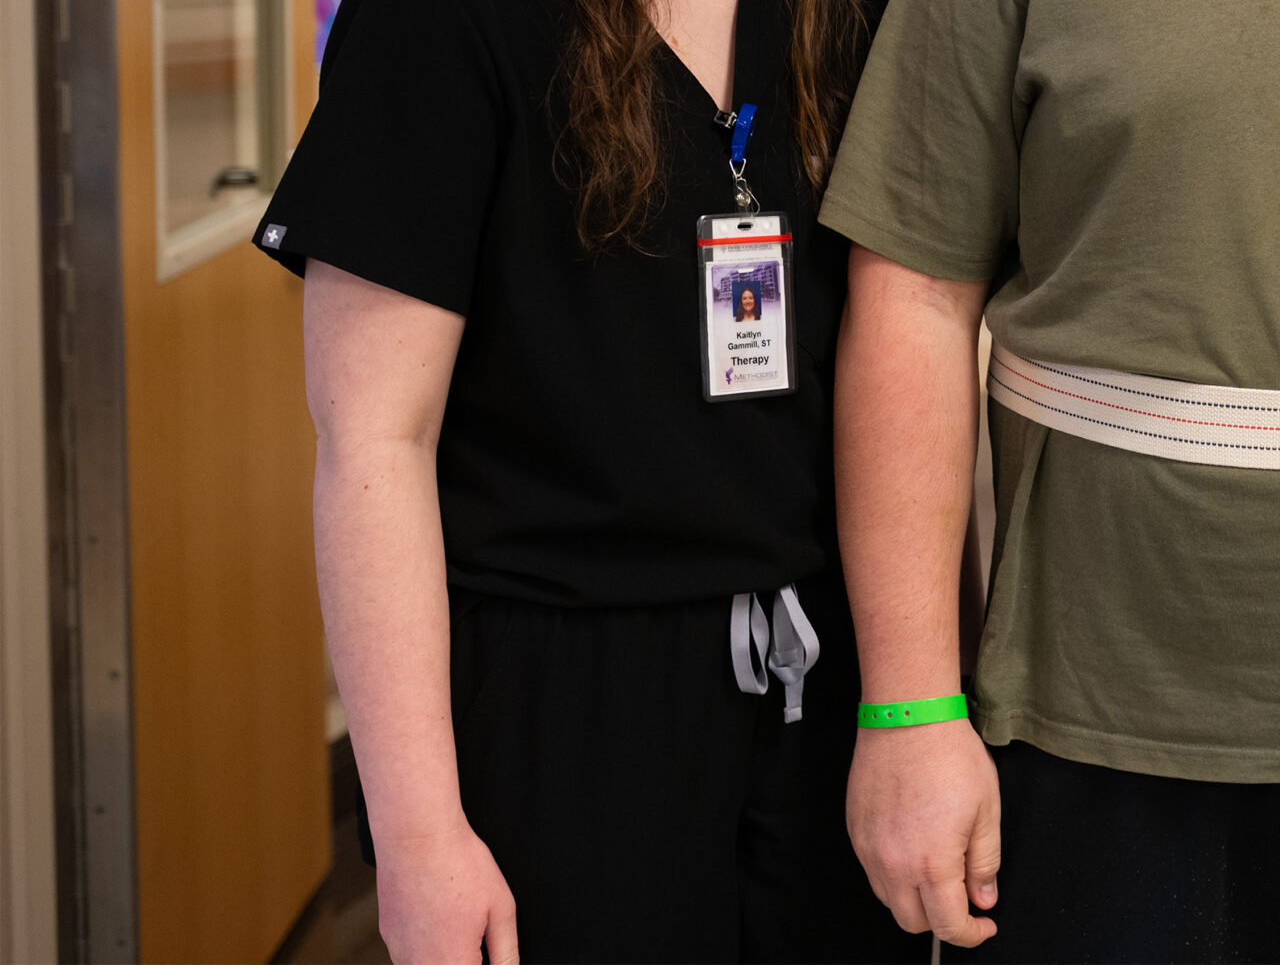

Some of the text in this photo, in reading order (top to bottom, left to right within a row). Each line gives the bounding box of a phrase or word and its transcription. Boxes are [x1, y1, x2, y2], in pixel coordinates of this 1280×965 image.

[736, 331, 762, 339] Kaitlyn
[728, 339, 771, 350] Gammill, ST
[731, 356, 769, 366] Therapy
